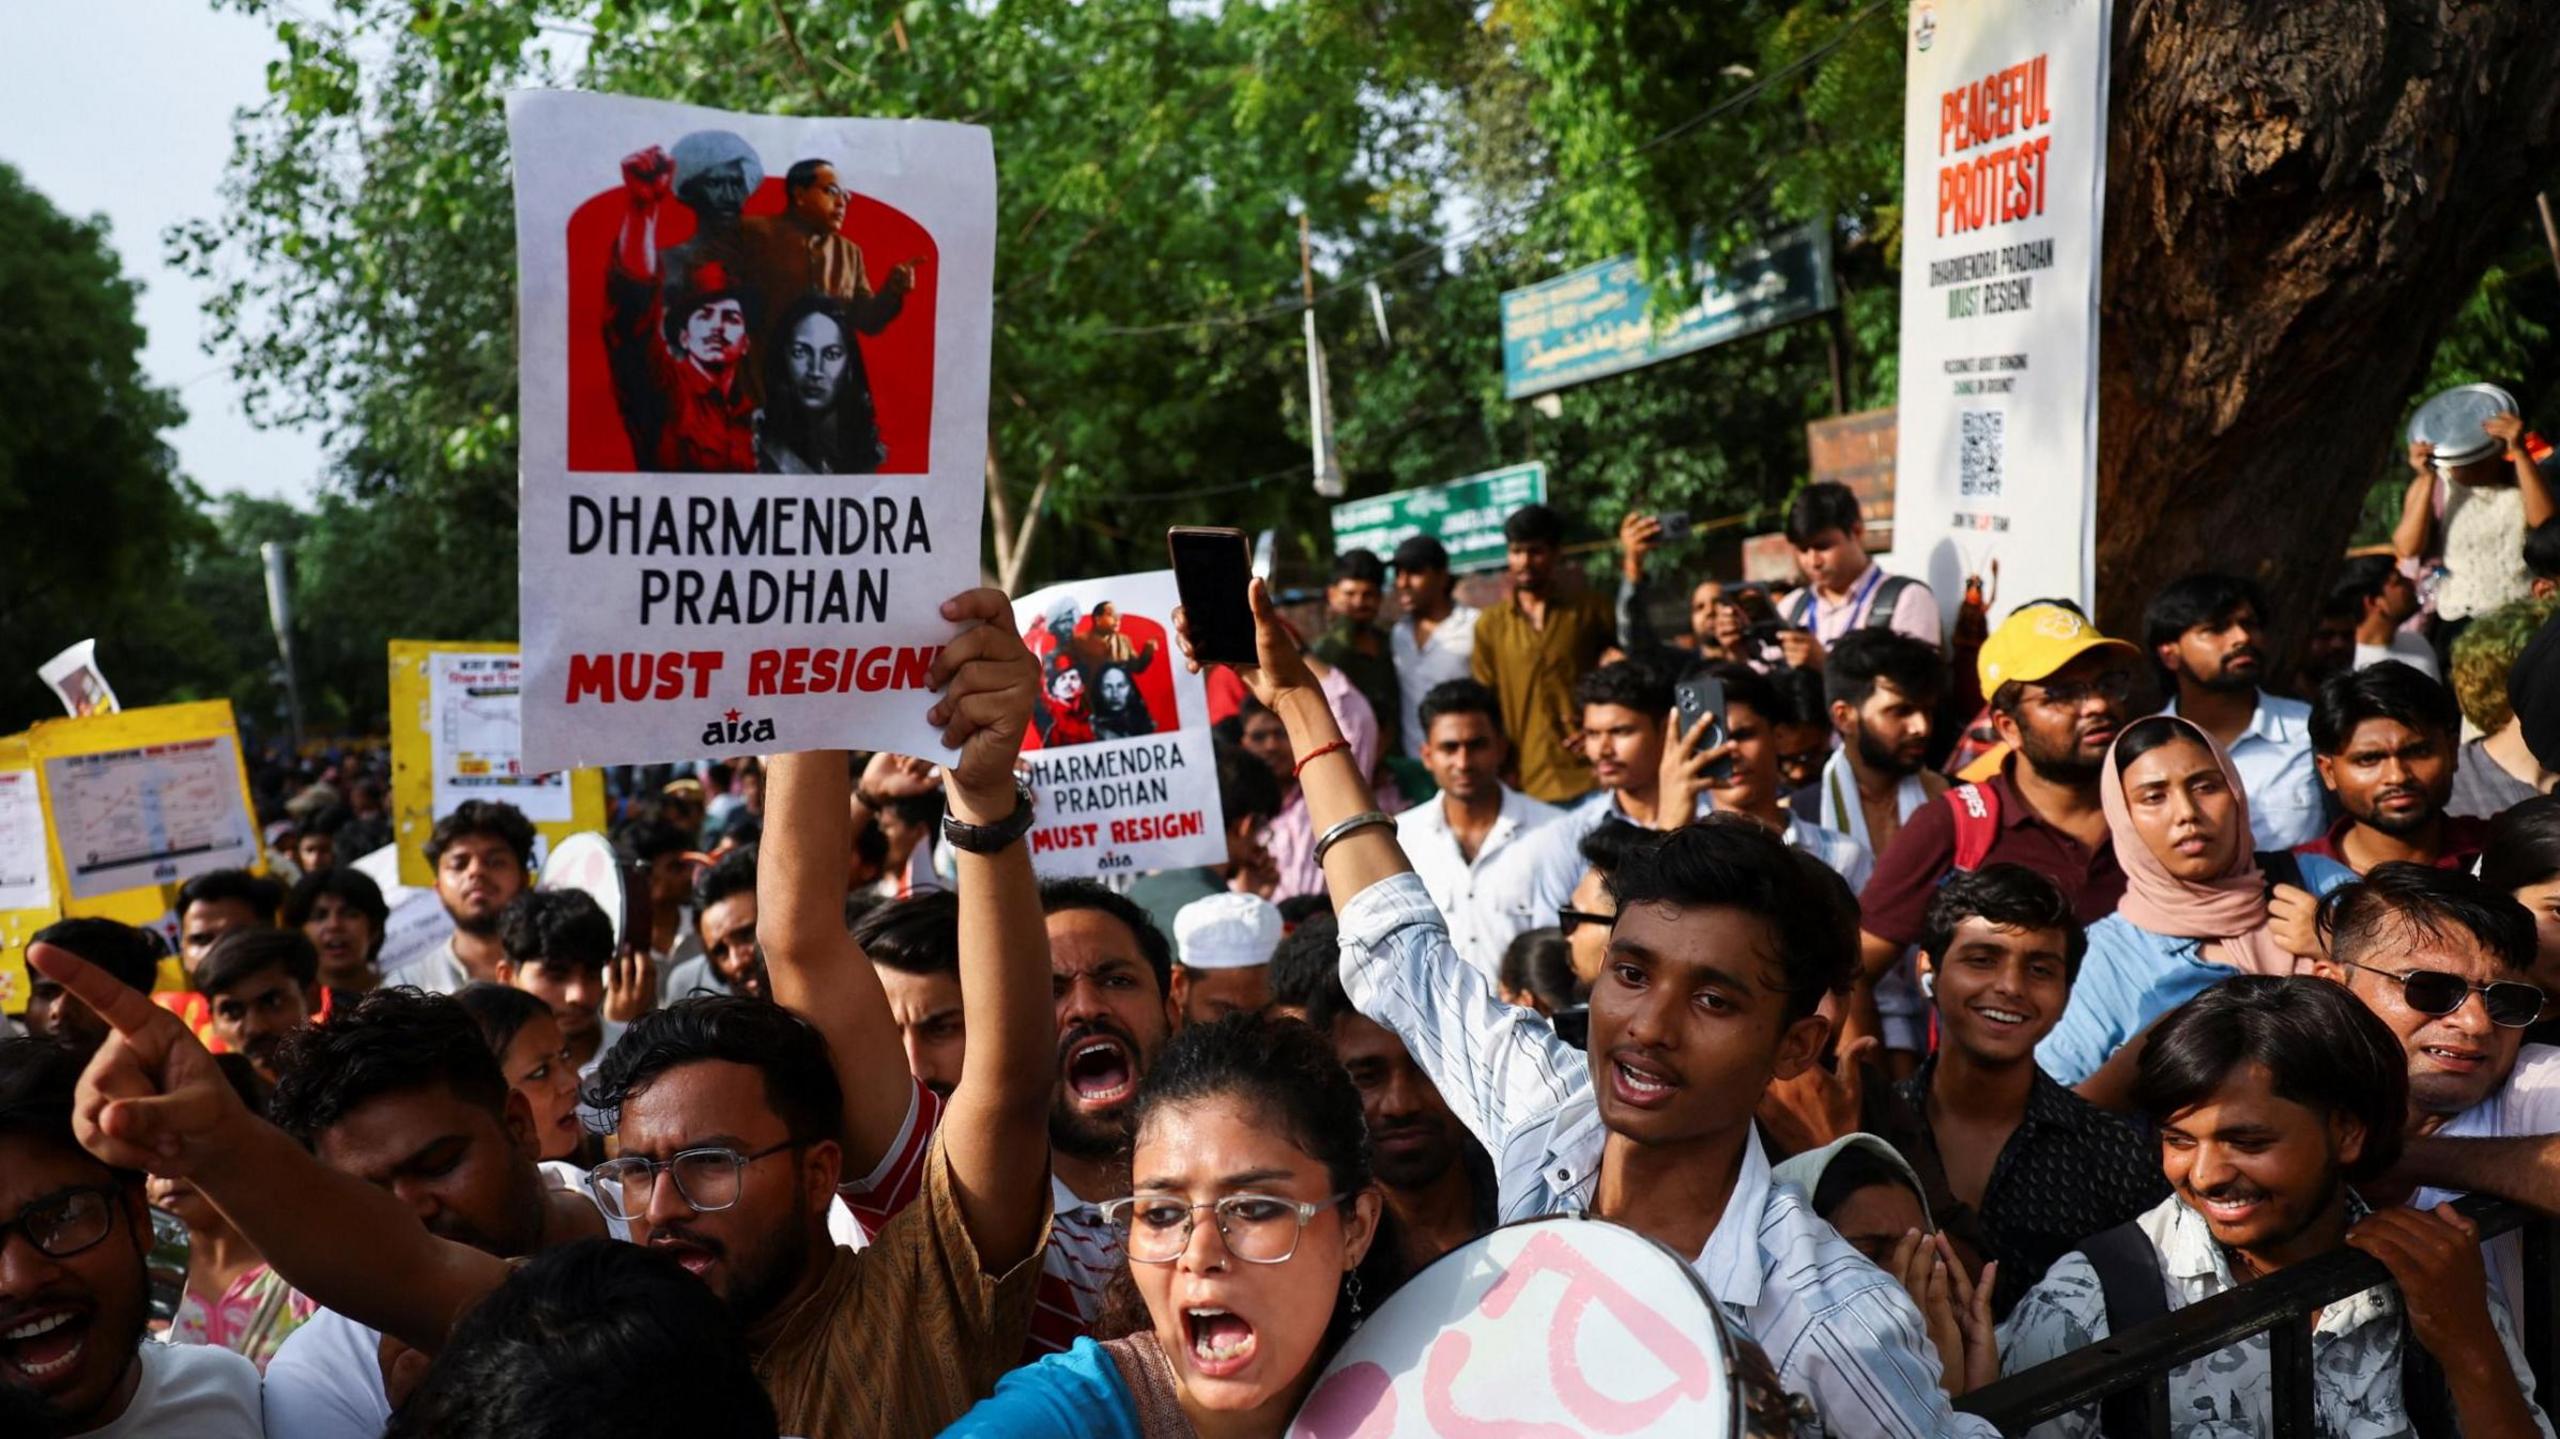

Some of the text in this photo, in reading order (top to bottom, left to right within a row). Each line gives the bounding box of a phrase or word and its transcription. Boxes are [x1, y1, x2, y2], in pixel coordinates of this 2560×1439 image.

[1940, 53, 2050, 157] PEACEFUL
[1937, 135, 2051, 239] PROTEST
[1929, 237, 2055, 288] DHARMENDRA PRADHAN
[1948, 285, 1981, 320] MUST
[568, 495, 931, 556] DHARMENDRA
[640, 568, 889, 625] PRADHAN
[566, 651, 723, 704] MUST
[701, 708, 776, 746] aisa
[1054, 777, 1168, 814] PRADHAN
[1032, 810, 1205, 854] MUST RESIGN!
